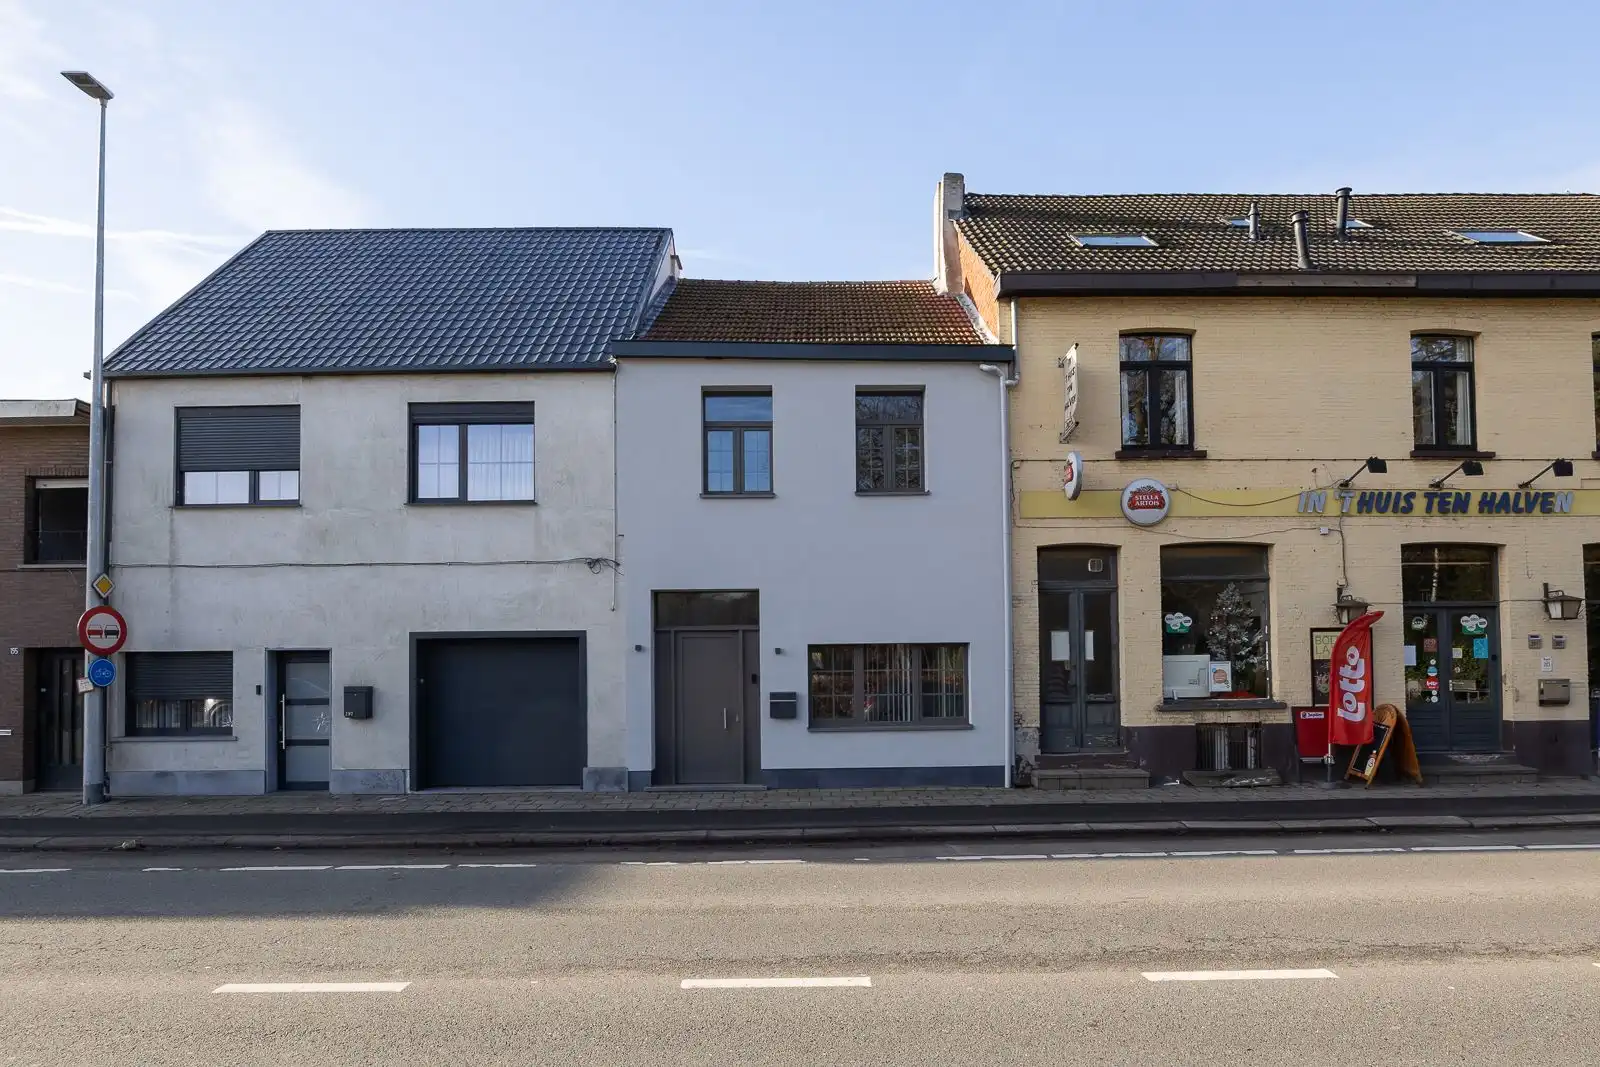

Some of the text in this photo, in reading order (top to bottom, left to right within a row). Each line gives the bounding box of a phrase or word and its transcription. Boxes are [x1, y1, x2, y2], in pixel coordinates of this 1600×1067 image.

[1297, 491, 1326, 513] IN
[1356, 491, 1416, 514] HUIS
[1423, 491, 1471, 514] TEN
[1478, 490, 1573, 514] HALVEN
